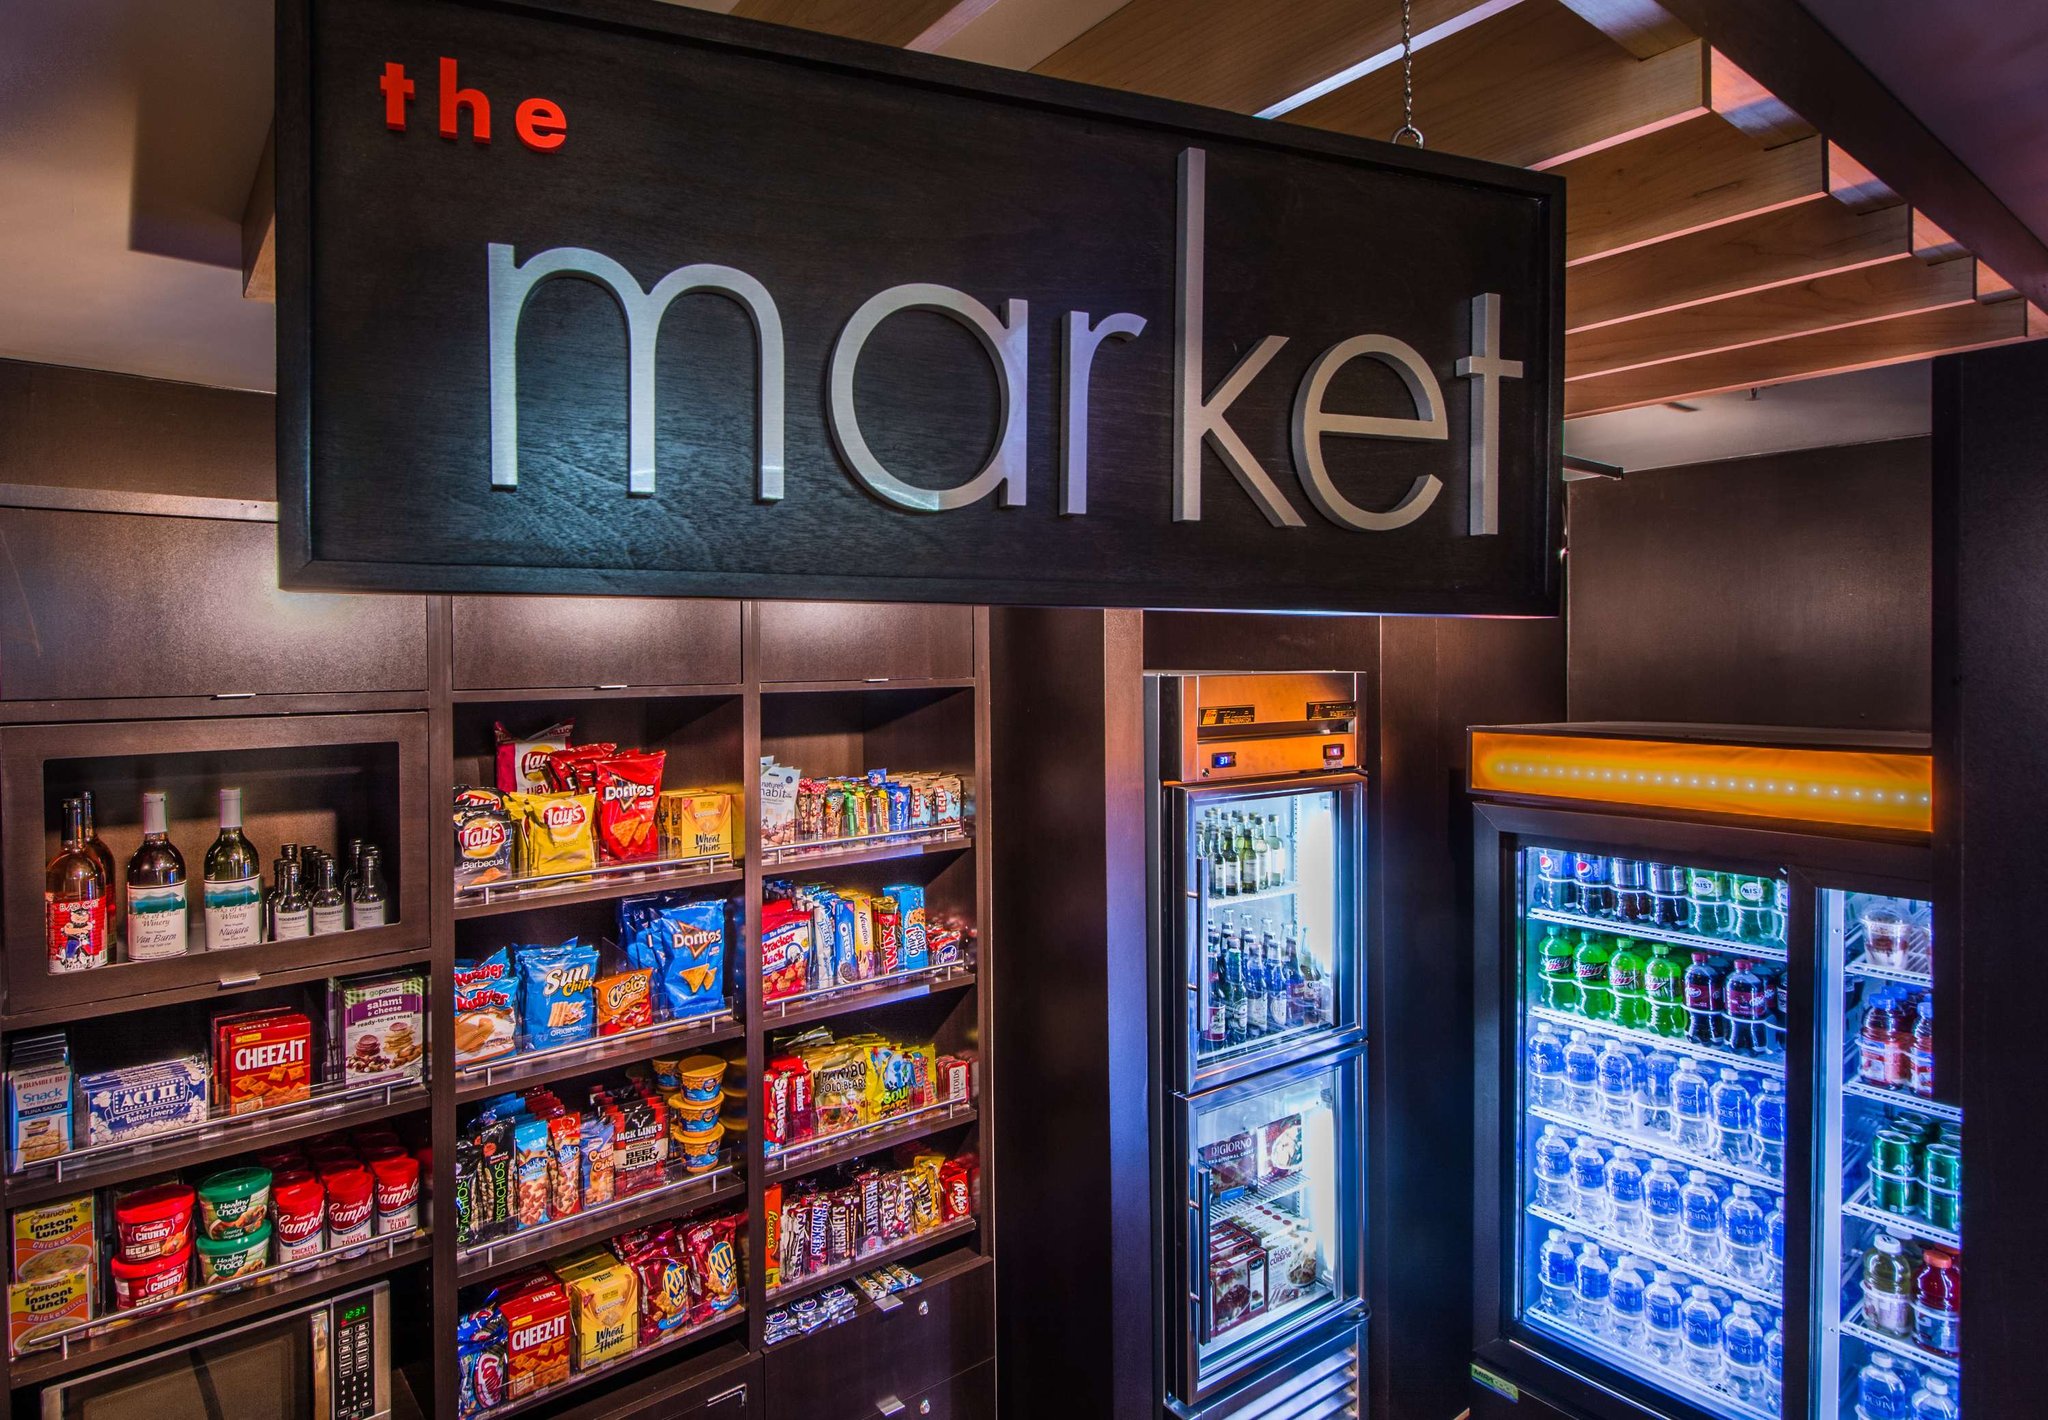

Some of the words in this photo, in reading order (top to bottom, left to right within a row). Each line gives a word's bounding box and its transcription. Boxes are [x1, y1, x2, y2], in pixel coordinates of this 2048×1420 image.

[379, 57, 568, 153] the
[487, 146, 1524, 536] market
[605, 784, 654, 801] Doritos
[694, 843, 720, 854] Thins
[695, 833, 720, 848] Wheat
[462, 858, 504, 870] Barbecue
[141, 918, 171, 929] Winery
[136, 934, 152, 945] Van
[673, 930, 722, 949] Doritos
[762, 932, 796, 955] Cracker
[840, 923, 852, 960] OREO
[543, 964, 590, 996] Sun
[562, 977, 594, 997] Chips
[608, 974, 648, 1010] Cheetos
[367, 996, 402, 1011] salami
[374, 1004, 402, 1016] cheese
[357, 1015, 396, 1028] ready-to-eat
[397, 1012, 413, 1021] meal
[235, 1038, 306, 1071] CHEEZ-IT
[821, 1060, 866, 1083] HARIBO
[22, 1088, 63, 1104] Snack
[121, 1088, 155, 1108] ACT
[158, 1083, 177, 1098] II
[24, 1108, 41, 1116] TUNA
[42, 1103, 63, 1113] SALAD
[126, 1111, 150, 1125] Butter
[150, 1107, 175, 1119] Lovers
[617, 1128, 637, 1142] JACK
[637, 1123, 663, 1138] LINK'S
[625, 1147, 655, 1160] BEEF
[1211, 1138, 1252, 1156] DIGIORNO
[623, 1151, 660, 1167] JERKY
[38, 1206, 76, 1220] Maruchan
[216, 1205, 248, 1217] Choice
[219, 1199, 249, 1210] Healthy
[866, 1182, 879, 1235] HERSHEY'S
[30, 1214, 79, 1233] Instant
[389, 1220, 408, 1230] CLAM
[768, 1211, 779, 1249] Reese's
[811, 1207, 823, 1255] SNICKERS
[833, 1206, 846, 1254] HERSHEY'S
[36, 1225, 74, 1240] Lunch
[32, 1236, 71, 1249] Chicken
[213, 1260, 244, 1272] Choice
[216, 1253, 246, 1264] Healthy
[33, 1278, 72, 1292] Maruchan
[664, 1265, 687, 1300] RITZ
[25, 1287, 74, 1306] Instant
[31, 1297, 69, 1312] Lunch
[27, 1309, 66, 1322] Chicken
[512, 1315, 567, 1351] CHEEZ-IT
[596, 1323, 625, 1344] Wheat
[594, 1336, 625, 1353] Thins
